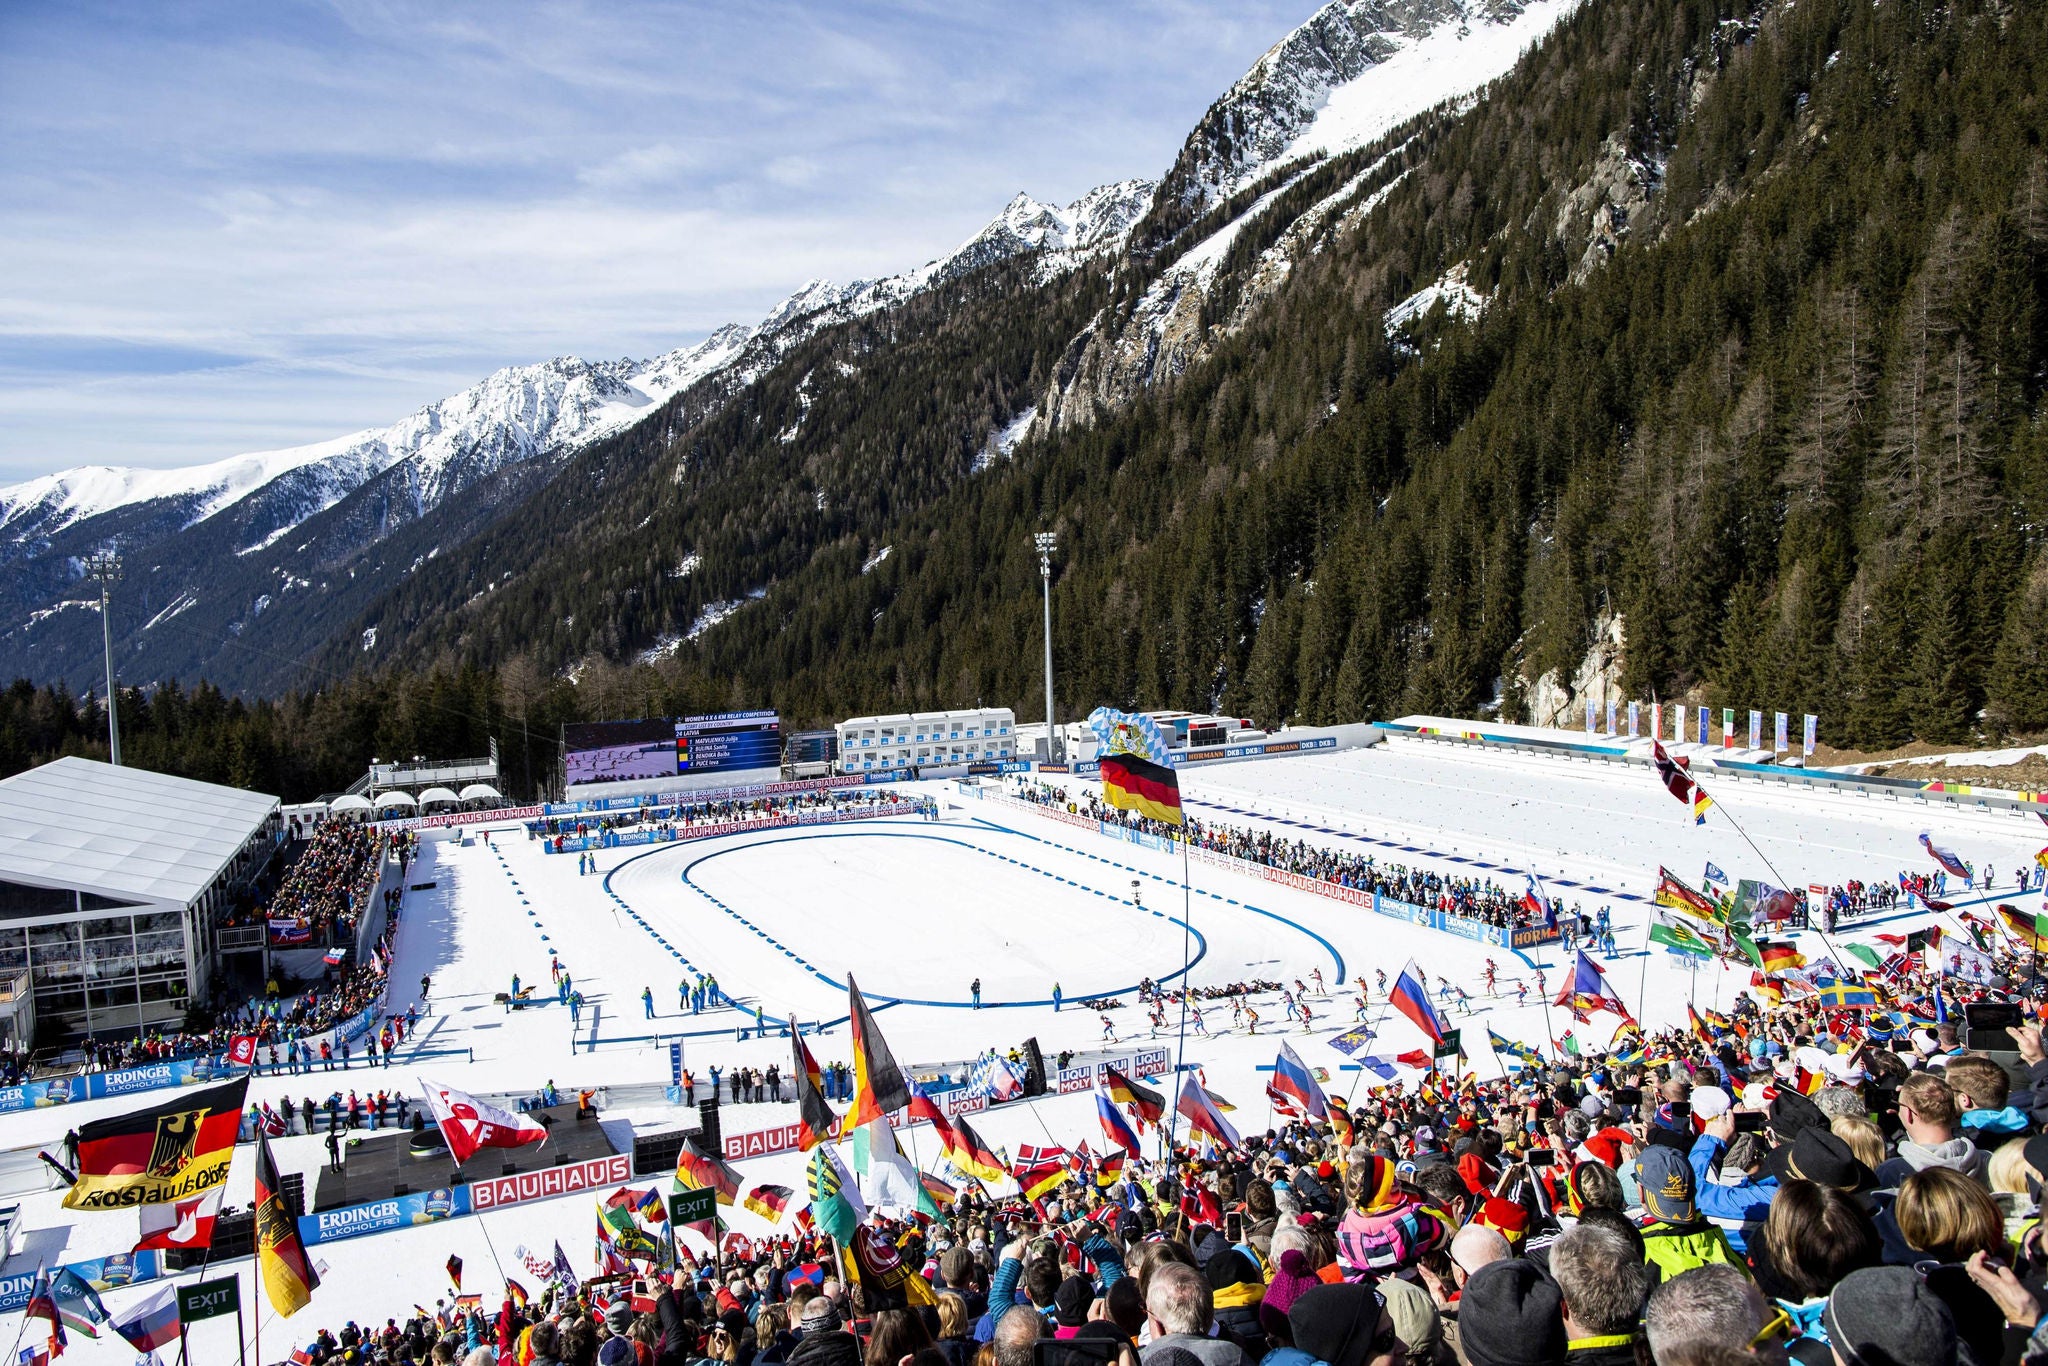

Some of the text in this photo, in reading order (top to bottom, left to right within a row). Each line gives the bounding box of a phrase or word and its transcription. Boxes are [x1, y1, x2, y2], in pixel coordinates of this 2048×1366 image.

[1003, 764, 1020, 772] DKB
[1080, 764, 1094, 772] DKB
[766, 775, 864, 793] BAUHAUS BAUHAUS
[551, 803, 578, 811] ERDINGER
[422, 806, 544, 828] BAUHAUS BAUHAUS
[620, 832, 649, 840] ERDINGER
[677, 823, 739, 838] BAUHAUS
[1264, 868, 1372, 908] BAUHAUS BAUHAUS
[337, 1012, 366, 1036] ERDINGER
[1136, 1051, 1164, 1066] LIQUI
[105, 1065, 172, 1086] ERDINGER
[1060, 1066, 1090, 1082] LIQUI
[1136, 1062, 1164, 1078] MOLY
[106, 1078, 171, 1092] ALKOHOLFREI
[1060, 1078, 1091, 1094] MOLY
[950, 1098, 982, 1114] MOLY
[476, 1160, 628, 1206] BAUHAUS
[677, 1198, 708, 1216] EXIT
[319, 1202, 401, 1229] ERDINGER
[320, 1216, 400, 1239] ALKOHOLFREI
[188, 1289, 230, 1310] EXIT
[207, 1306, 214, 1315] 3
